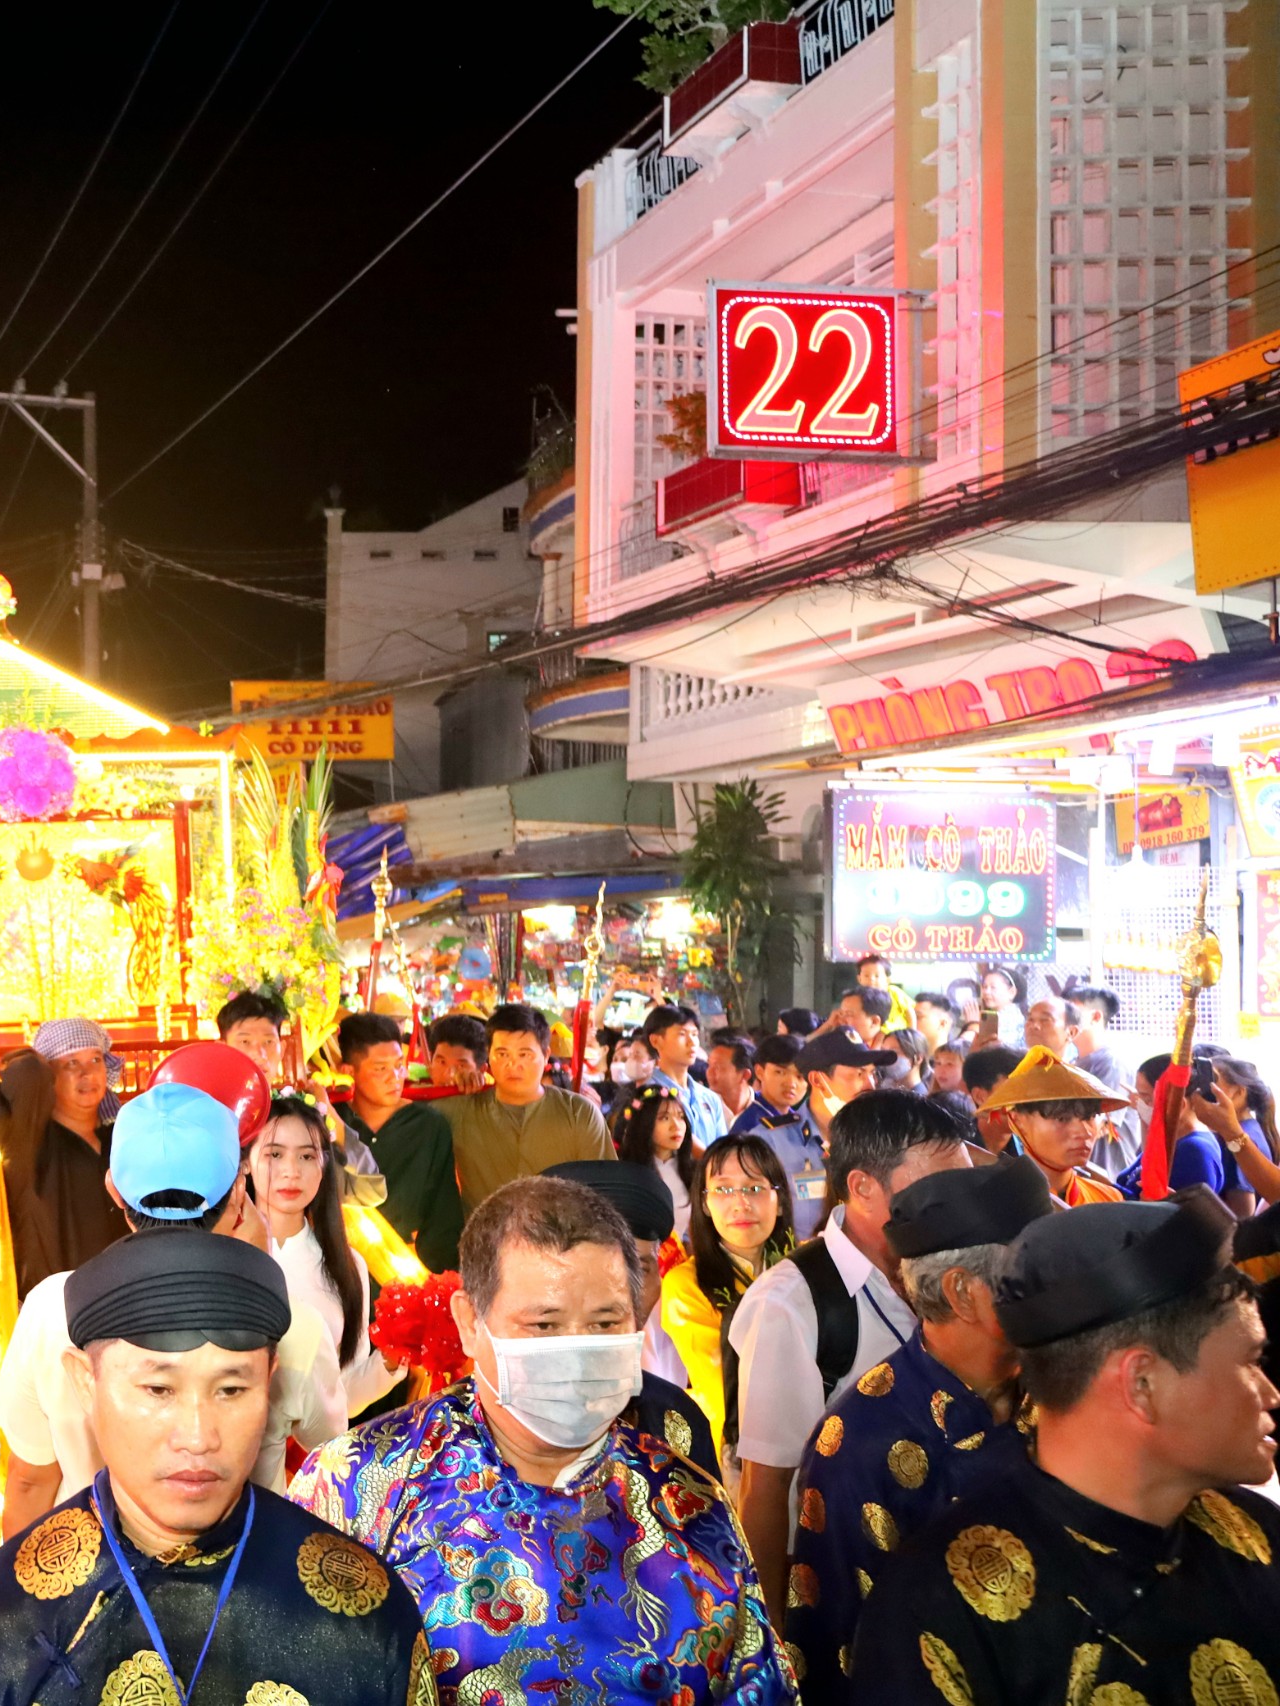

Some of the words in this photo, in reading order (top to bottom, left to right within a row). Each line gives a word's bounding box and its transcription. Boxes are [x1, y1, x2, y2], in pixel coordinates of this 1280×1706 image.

[734, 305, 879, 436] 22
[267, 719, 365, 734] 11111
[827, 677, 989, 752] PHÒNG
[925, 813, 962, 873] CÔ
[977, 807, 1047, 874] THẢO
[1166, 830, 1183, 844] 160
[1186, 825, 1205, 840] 379
[868, 917, 917, 951] CÔ
[925, 914, 1024, 953] THẢO
